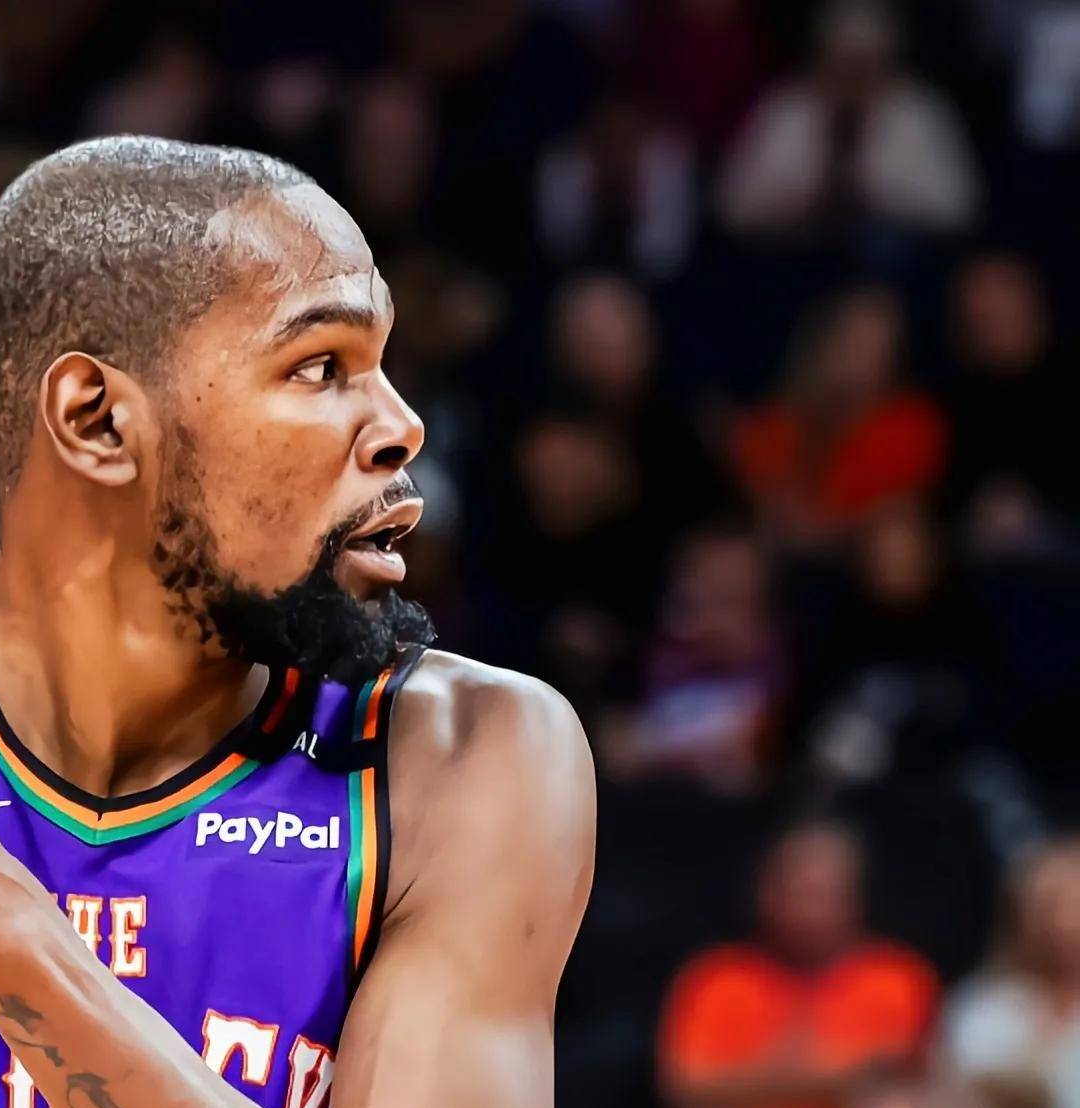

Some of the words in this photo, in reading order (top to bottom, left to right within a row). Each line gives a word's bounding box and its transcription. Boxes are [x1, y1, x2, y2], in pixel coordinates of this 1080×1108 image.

[292, 730, 318, 759] AL
[195, 811, 340, 854] PayPal
[50, 893, 147, 978] HE
